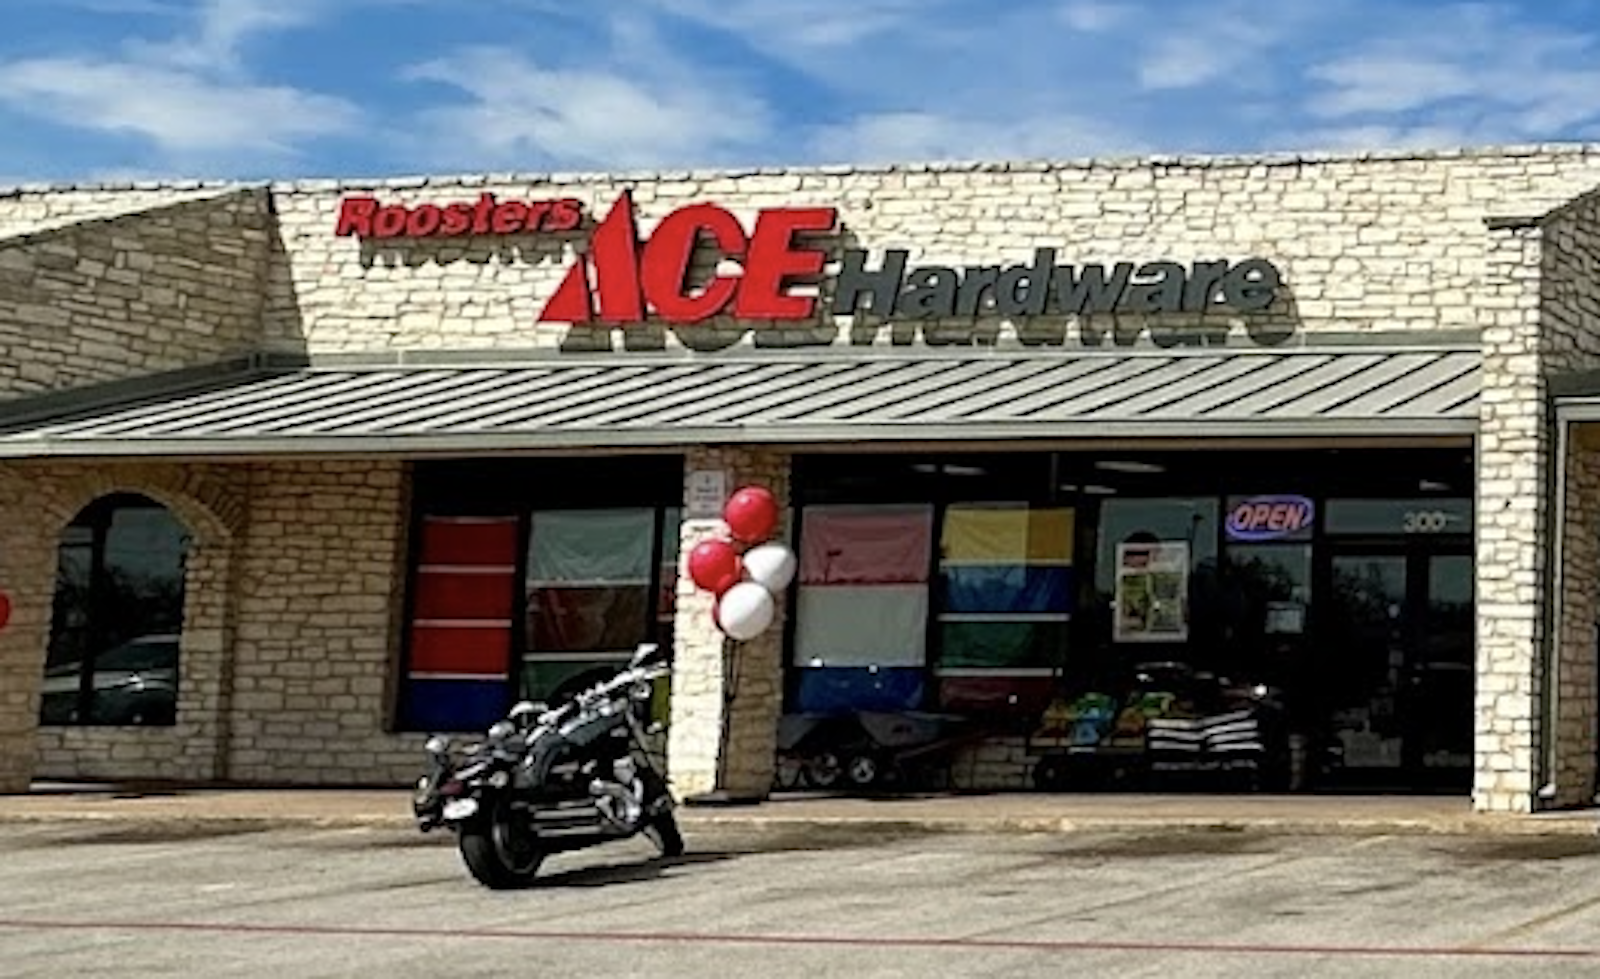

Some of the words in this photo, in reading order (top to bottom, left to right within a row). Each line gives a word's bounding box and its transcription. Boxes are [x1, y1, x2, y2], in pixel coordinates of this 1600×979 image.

[335, 192, 584, 237] Roosters
[537, 188, 837, 323] ACE
[833, 247, 1281, 317] Hardware
[1233, 503, 1305, 531] OPEN
[1403, 511, 1446, 532] 300
